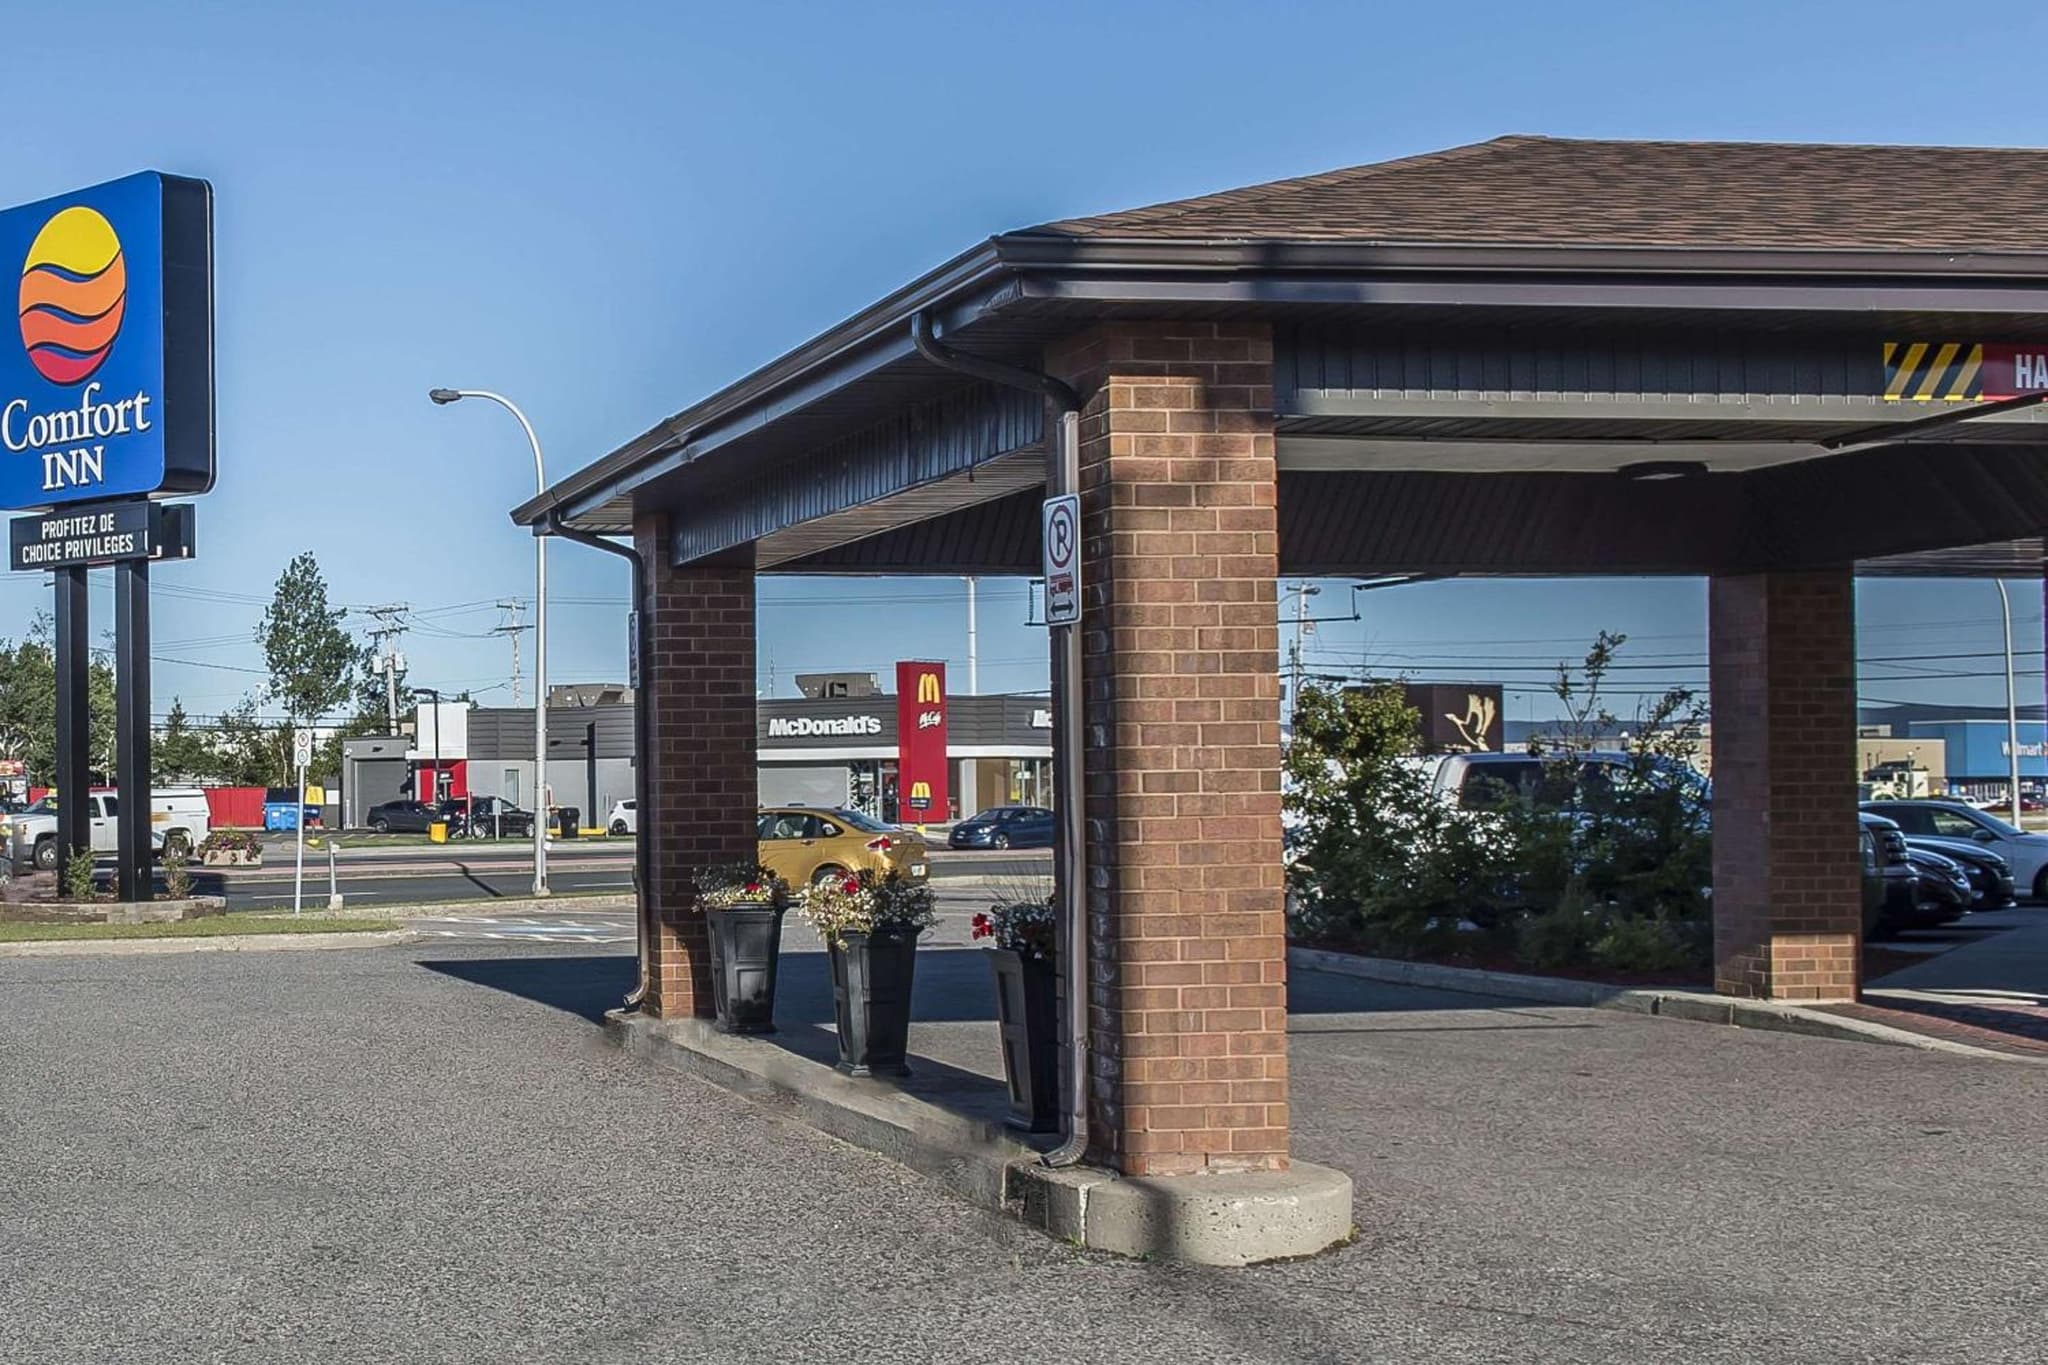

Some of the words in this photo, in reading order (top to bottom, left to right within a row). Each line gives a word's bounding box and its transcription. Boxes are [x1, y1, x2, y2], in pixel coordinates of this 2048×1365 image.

[2, 382, 151, 451] Comfort
[42, 446, 104, 490] INN
[42, 515, 96, 540] PROFITEZ
[100, 513, 115, 532] DE
[22, 542, 61, 564] CHOICE
[65, 534, 134, 559] PRIVILEGES
[768, 716, 882, 736] McDonald's
